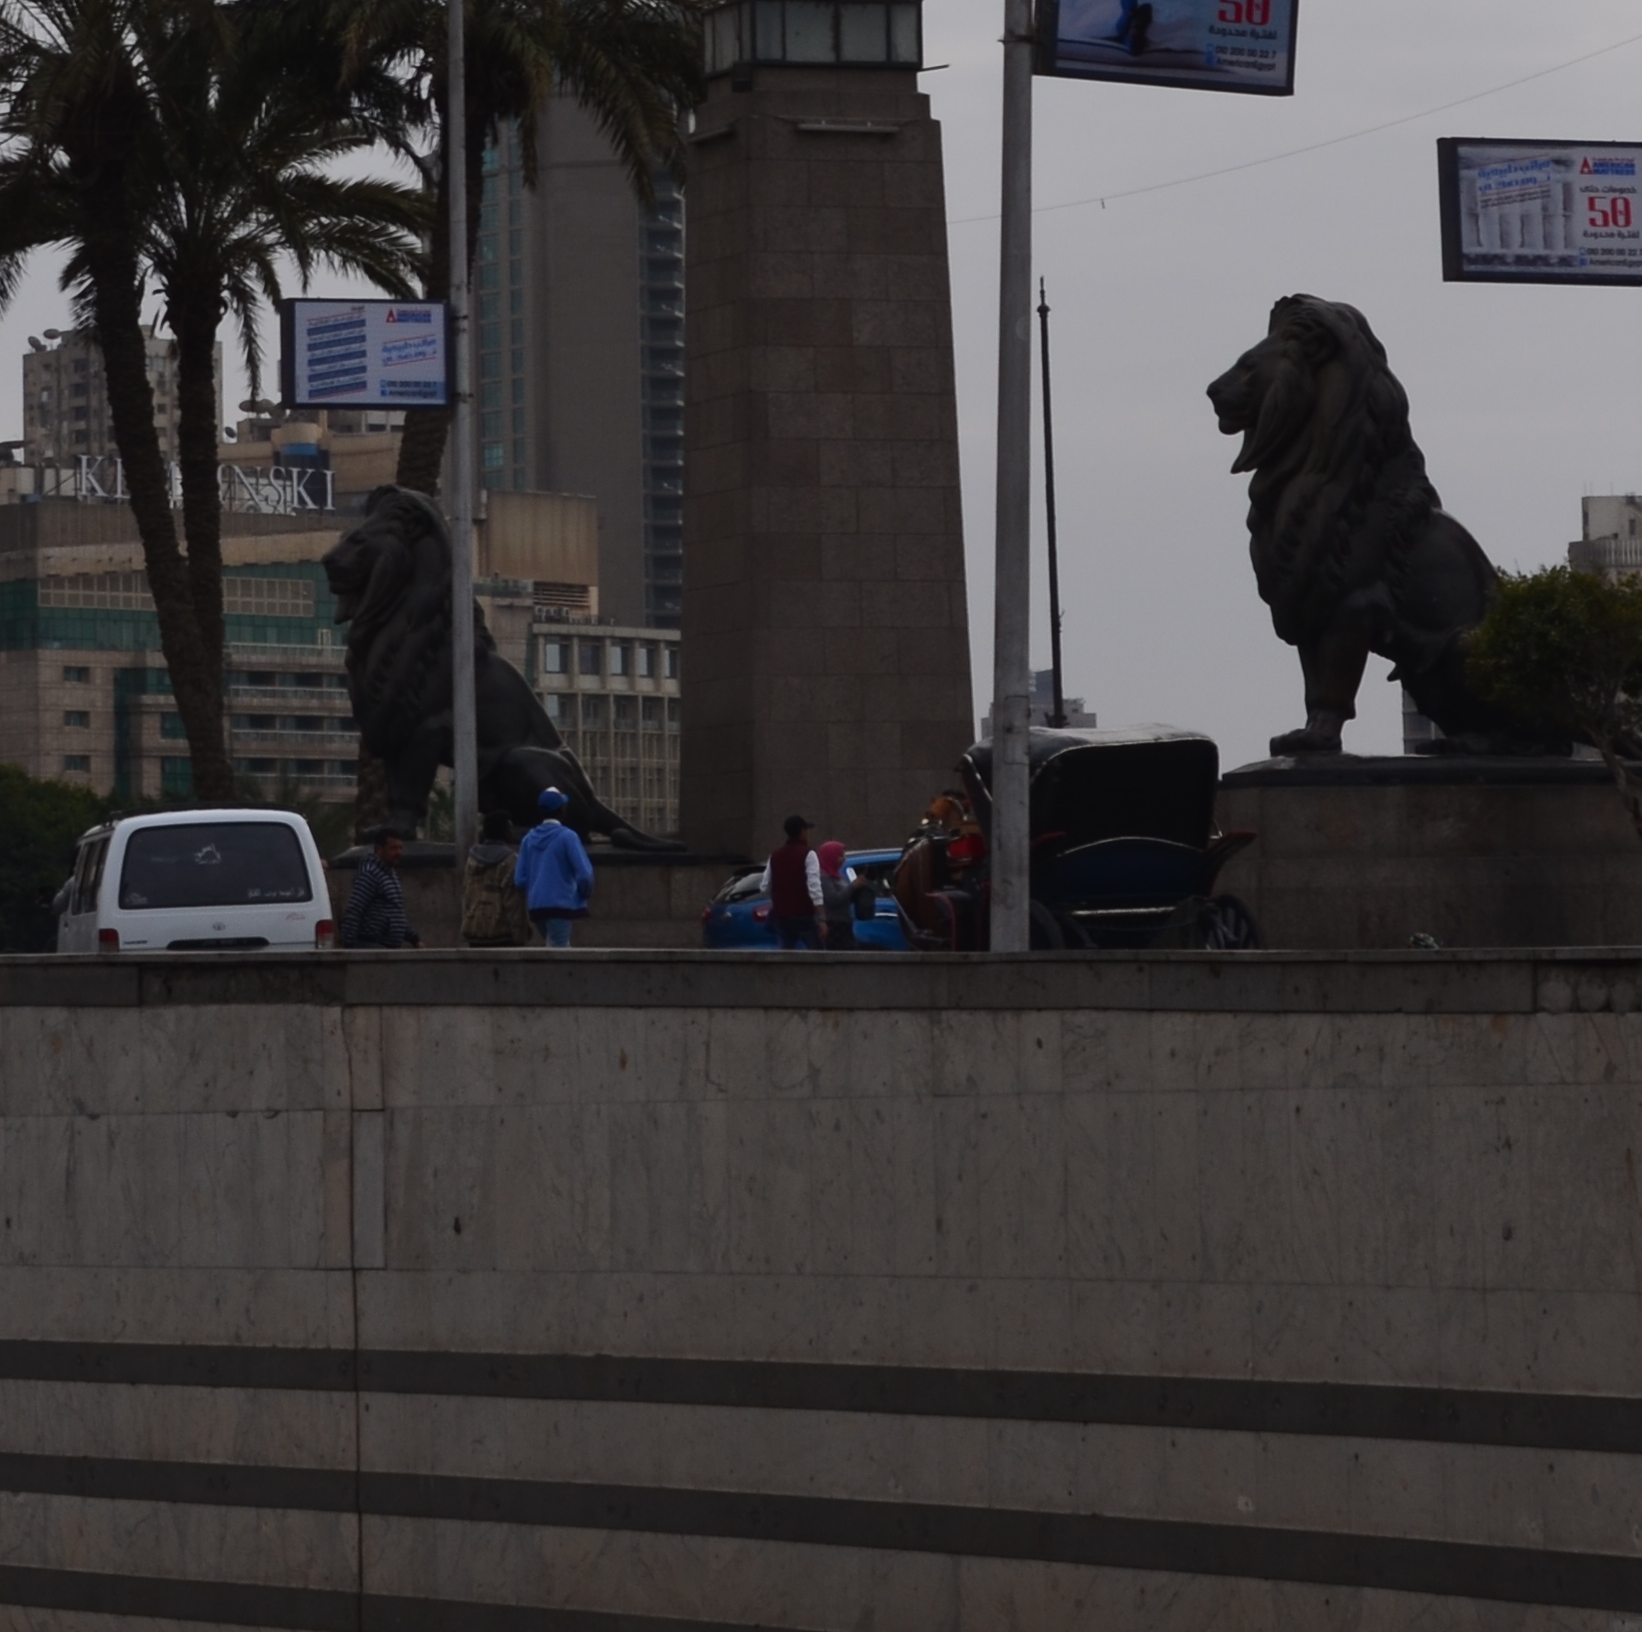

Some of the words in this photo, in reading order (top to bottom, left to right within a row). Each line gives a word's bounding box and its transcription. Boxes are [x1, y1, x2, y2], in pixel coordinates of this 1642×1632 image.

[1208, 25, 1249, 38] محدودة
[1250, 28, 1277, 40] لفترة
[1579, 185, 1600, 194] حتى
[1602, 185, 1637, 195] خصومات
[1583, 230, 1616, 239] محدودة
[1617, 230, 1640, 240] لفترة
[78, 455, 335, 510] KINSKI
